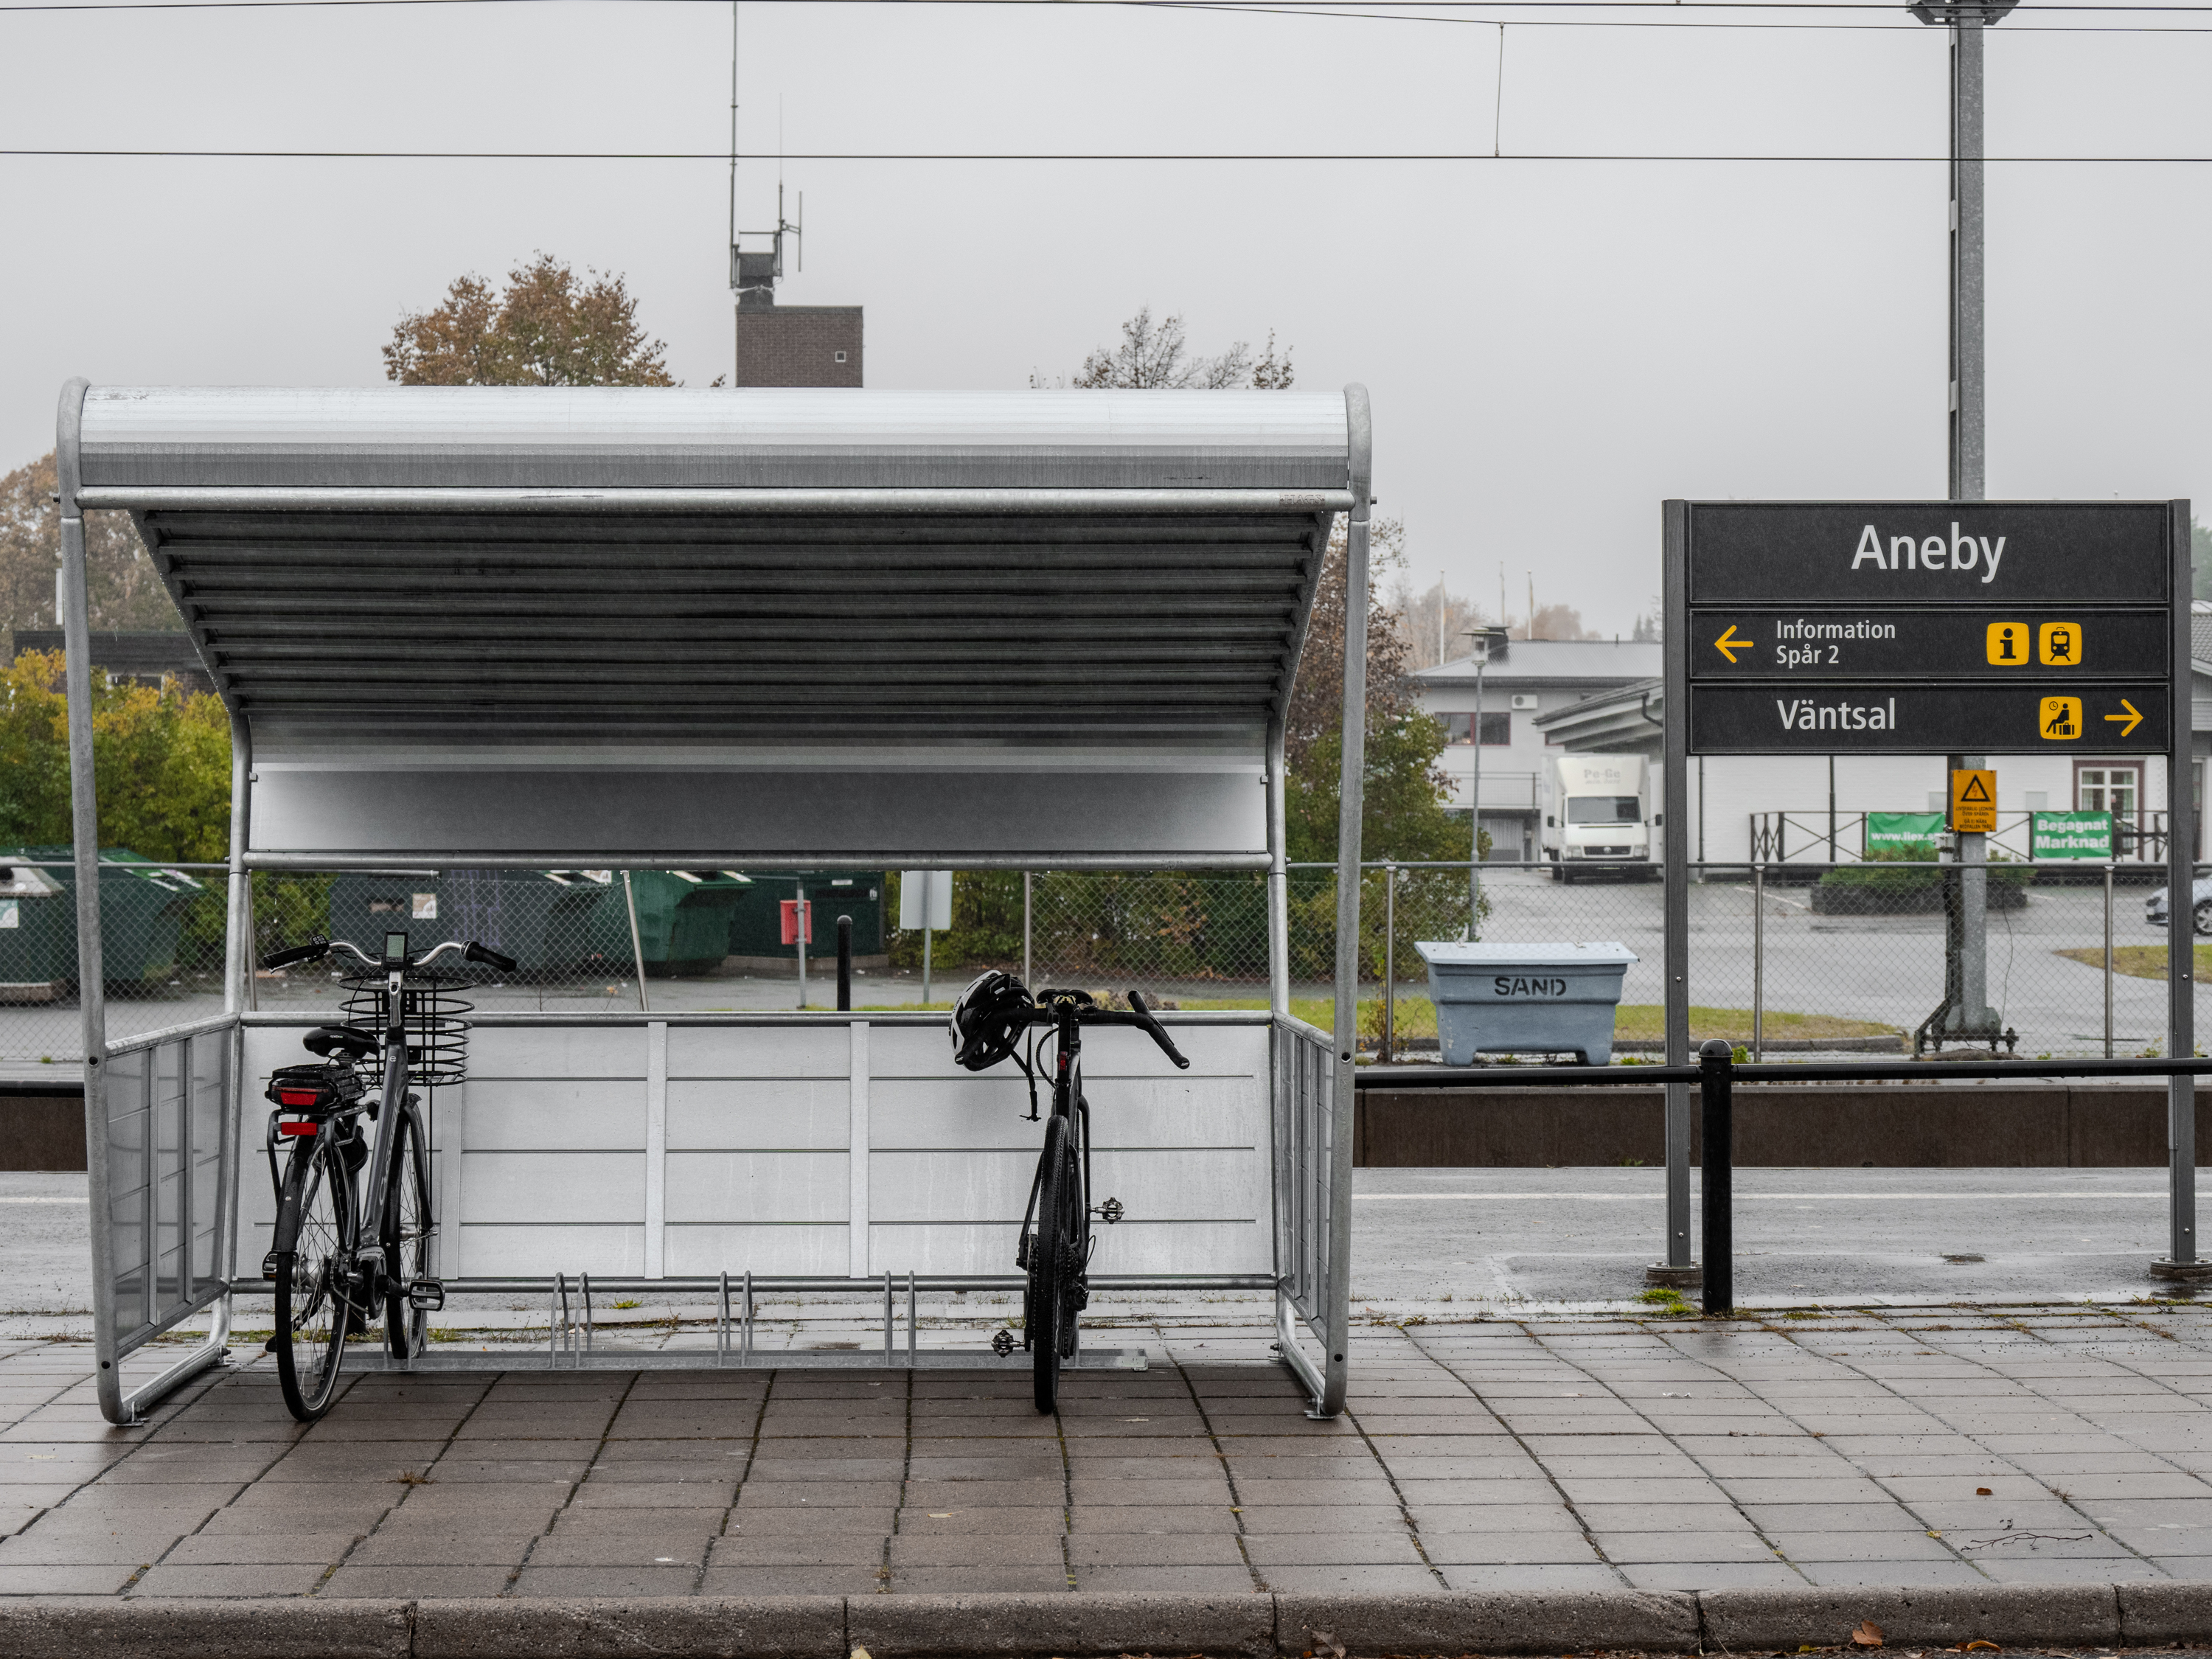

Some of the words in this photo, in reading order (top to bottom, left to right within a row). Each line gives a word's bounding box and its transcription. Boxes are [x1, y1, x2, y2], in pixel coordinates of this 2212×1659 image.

[1851, 521, 2006, 583] Aneby
[1777, 619, 1896, 639] Information
[1776, 643, 1822, 668] Spår
[1828, 644, 1839, 664] 2
[1776, 698, 1895, 730] Väntsal
[1583, 768, 1621, 779] Pe-Ge
[2037, 819, 2108, 833] Begagnat
[2036, 835, 2109, 849] Marknad
[1495, 977, 1567, 996] SAND
